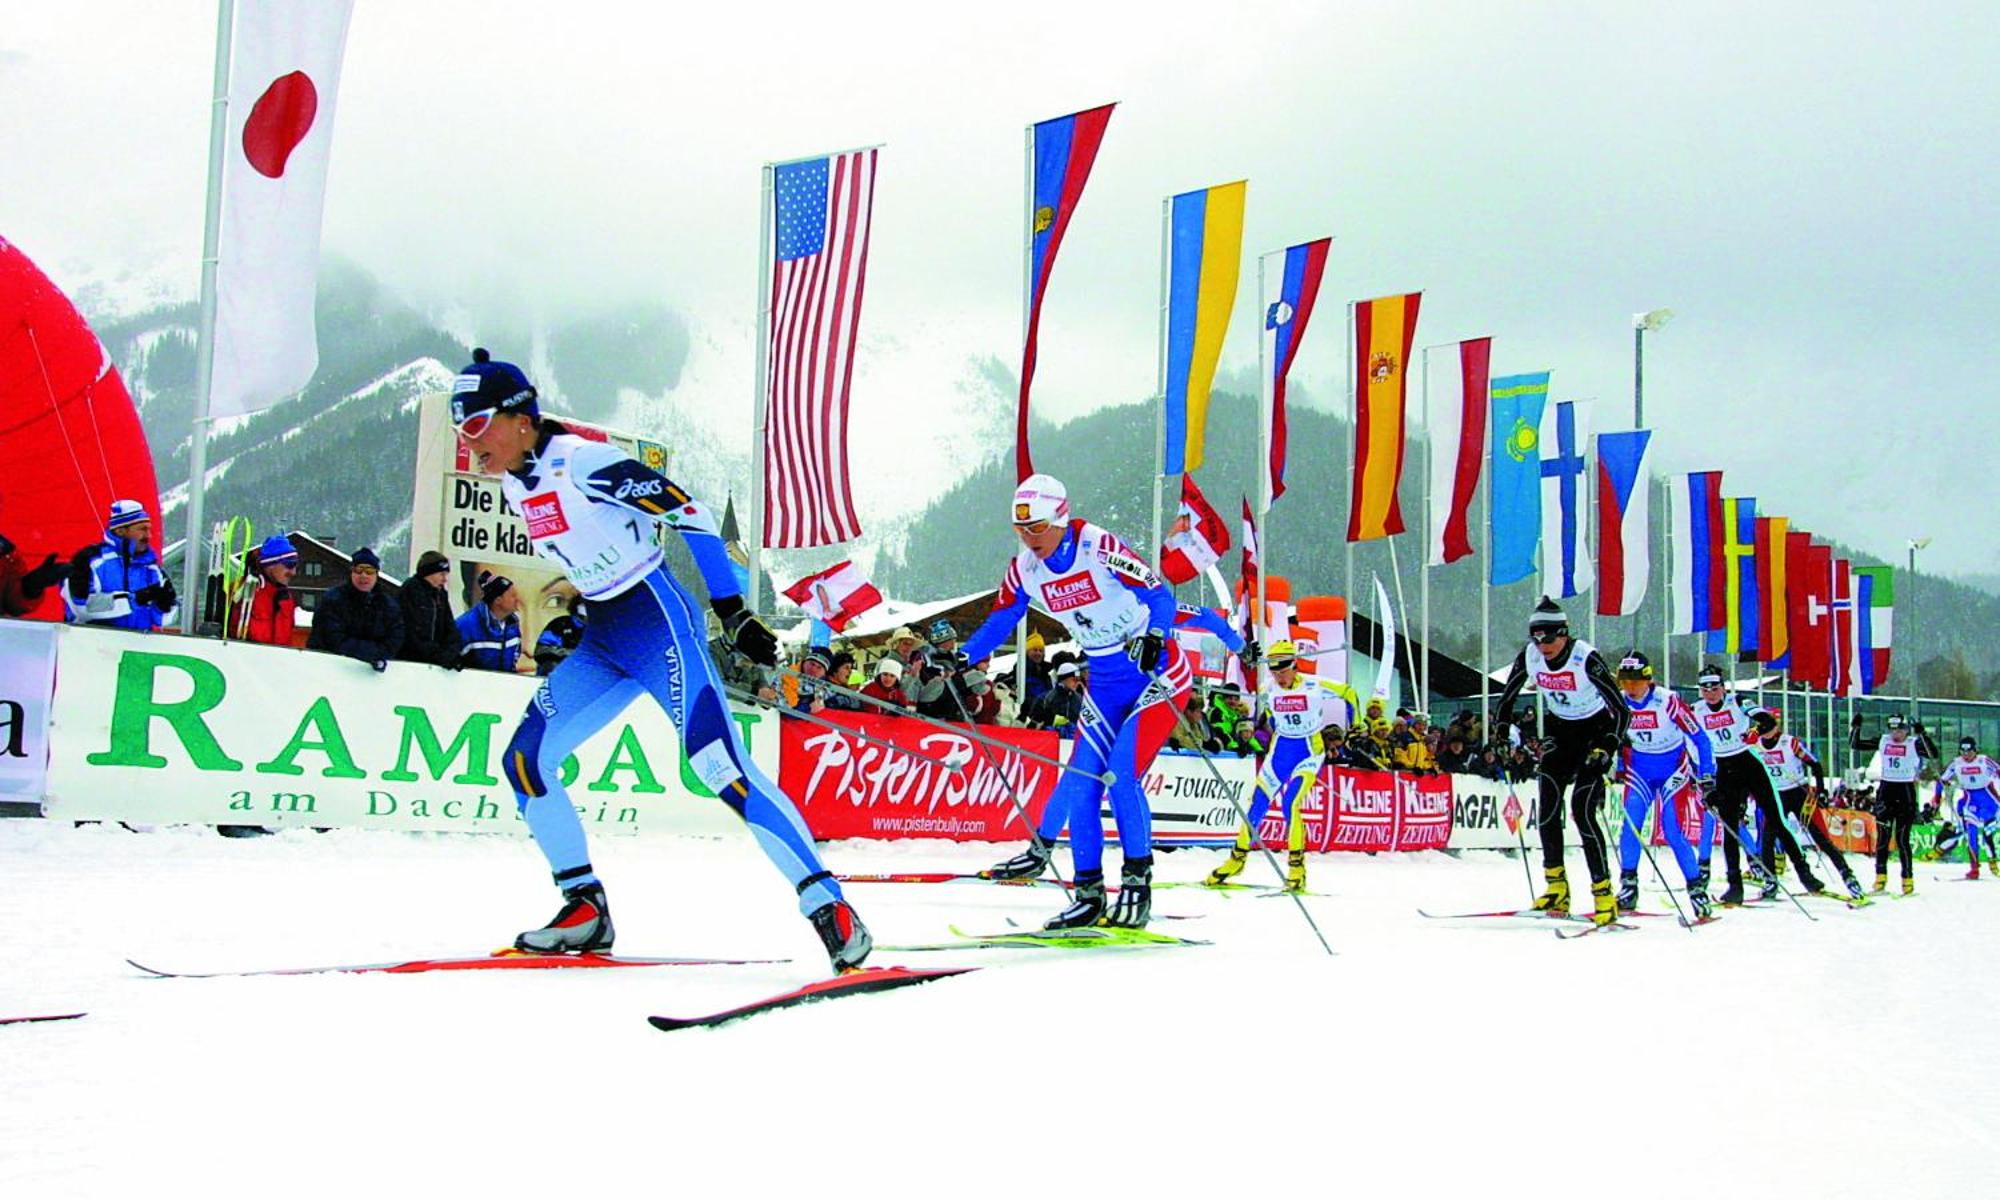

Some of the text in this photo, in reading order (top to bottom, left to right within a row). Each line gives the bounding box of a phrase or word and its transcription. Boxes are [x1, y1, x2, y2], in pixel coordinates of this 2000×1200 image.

[454, 479, 493, 512] Die
[451, 517, 489, 550] die
[1044, 577, 1092, 600] KLEINE
[1074, 611, 1094, 630] 4
[538, 679, 557, 718] TALIA
[1549, 691, 1571, 705] 12
[1283, 713, 1302, 725] 18
[1636, 731, 1652, 742] 17
[1715, 728, 1732, 742] 10
[1888, 757, 1901, 768] 16
[1338, 775, 1393, 813] KLEINE
[1404, 780, 1449, 814] KLEINE
[229, 790, 642, 823] am Dachein
[1455, 793, 1498, 829] AGFA
[872, 817, 985, 833] www.pistenbully.com
[1334, 823, 1392, 845] ZEITUNG
[1402, 823, 1449, 844] ZEITUNG
